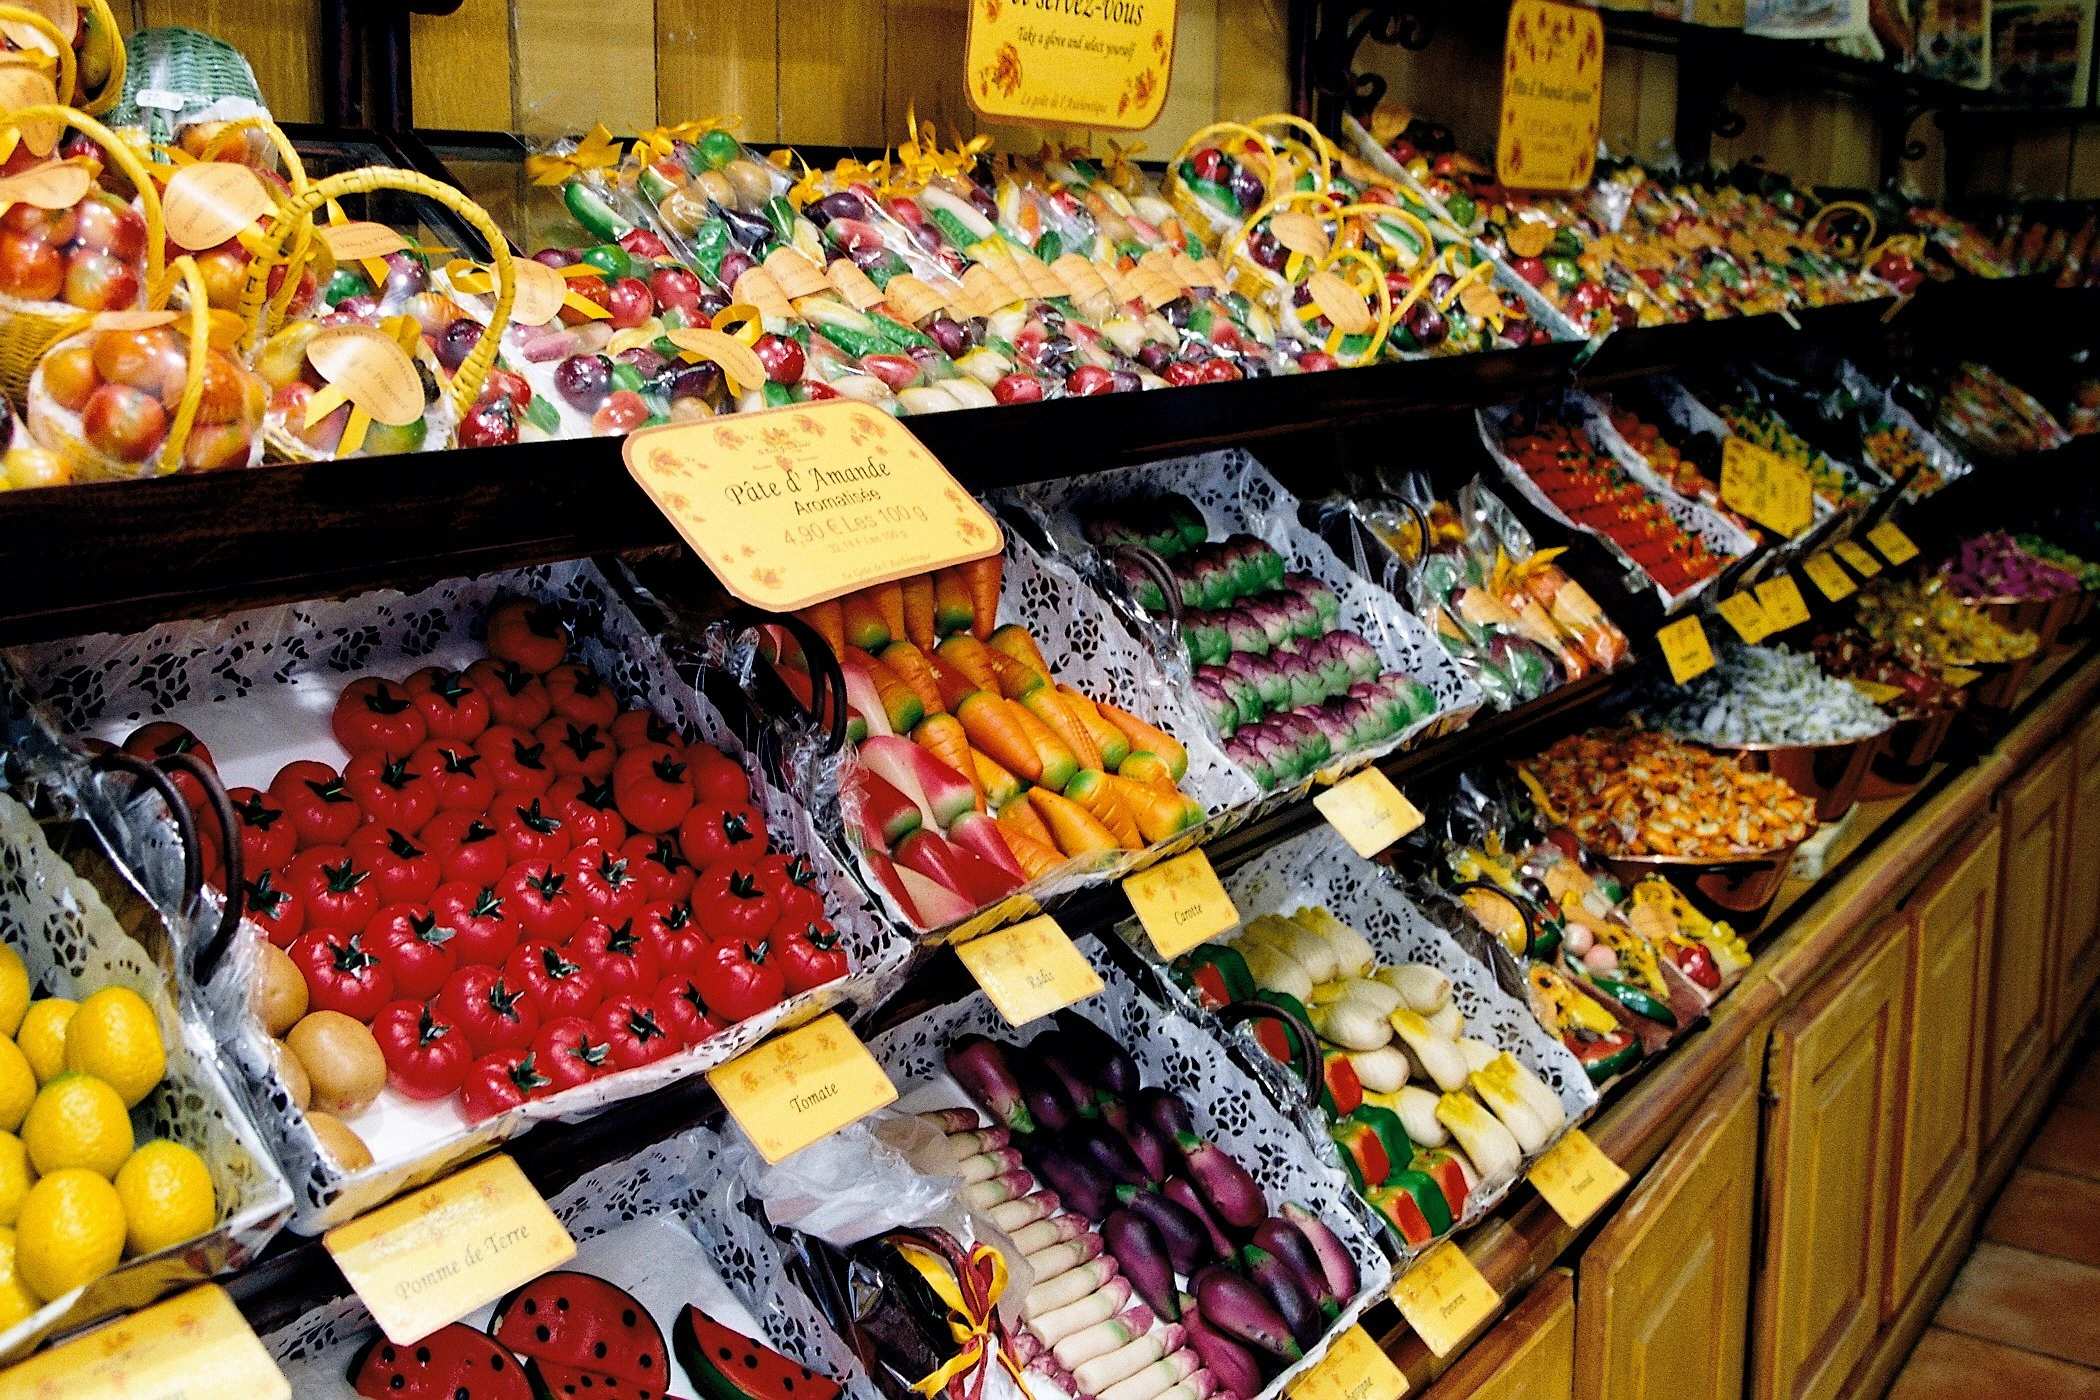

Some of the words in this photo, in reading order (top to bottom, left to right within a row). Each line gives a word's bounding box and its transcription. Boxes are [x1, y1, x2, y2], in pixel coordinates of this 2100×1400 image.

[1067, 34, 1083, 49] and
[724, 480, 782, 505] Pâte
[808, 456, 891, 492] Amande
[794, 488, 881, 515] Aromatisée
[784, 522, 825, 548] 4,90
[826, 518, 843, 536] €
[842, 514, 878, 533] Les
[878, 504, 912, 525] 100
[912, 505, 928, 523] g
[789, 1082, 839, 1113] Tomate
[396, 1259, 461, 1301] Pomme
[464, 1243, 484, 1268] de
[484, 1224, 531, 1254] Terre
